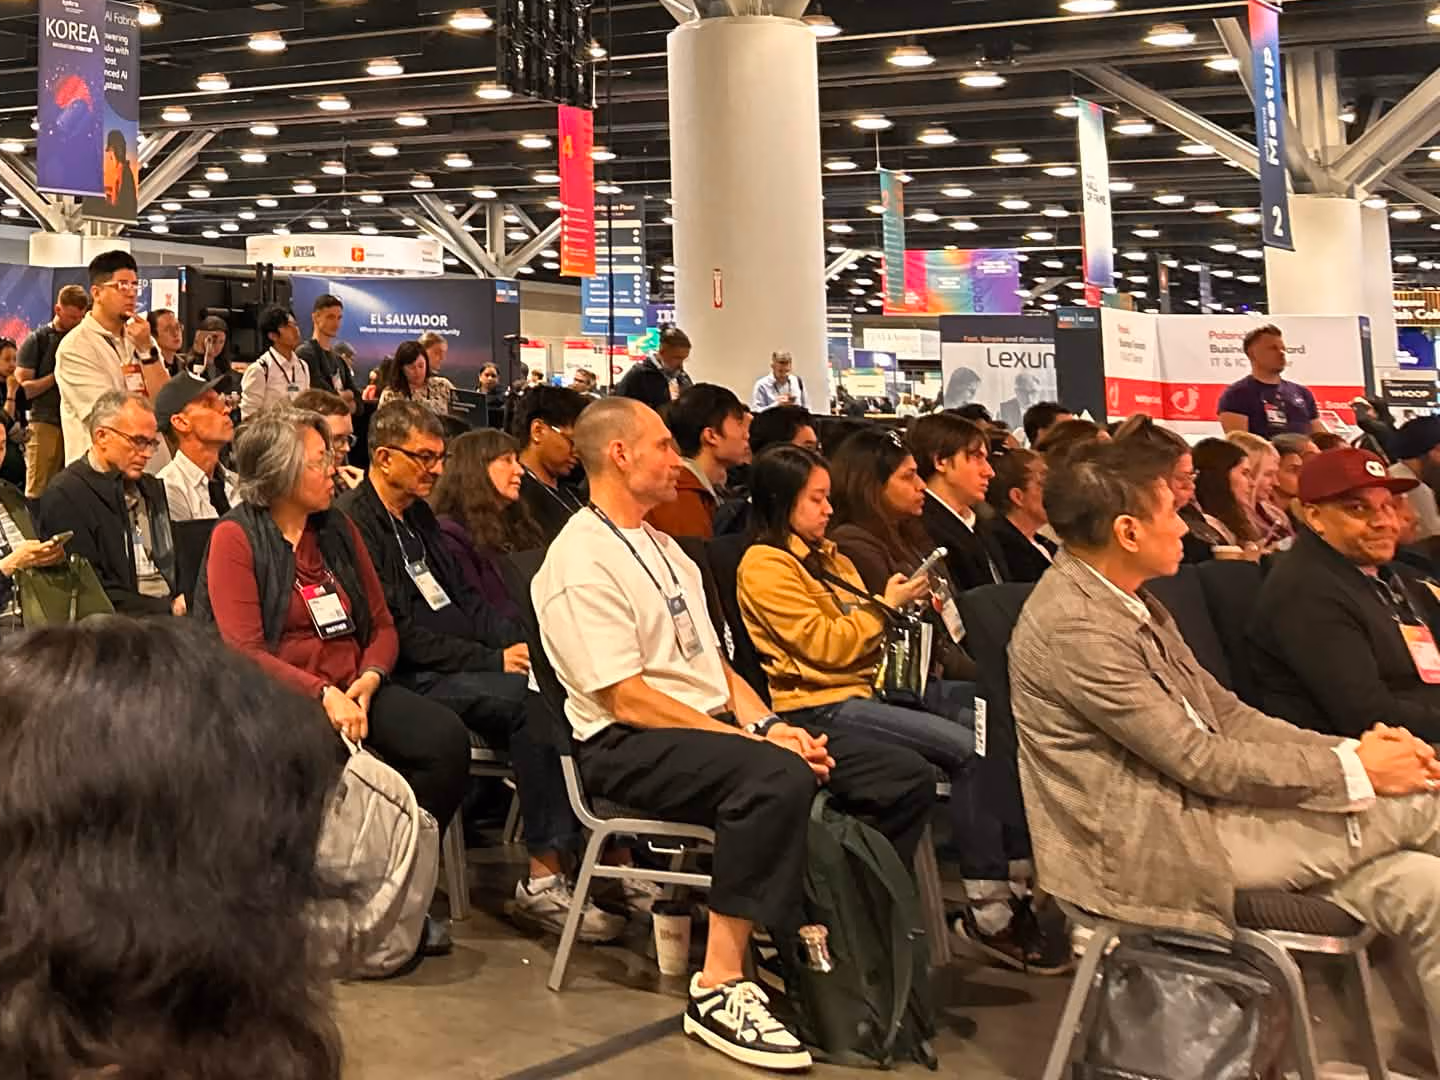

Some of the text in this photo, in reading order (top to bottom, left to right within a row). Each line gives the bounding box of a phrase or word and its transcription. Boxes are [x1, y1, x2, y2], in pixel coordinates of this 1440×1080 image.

[46, 17, 100, 45] KOREA
[113, 12, 137, 27] Fabric
[1263, 47, 1279, 166] Meetup
[1272, 205, 1283, 237] 2
[370, 313, 448, 327] EL SALVADOR
